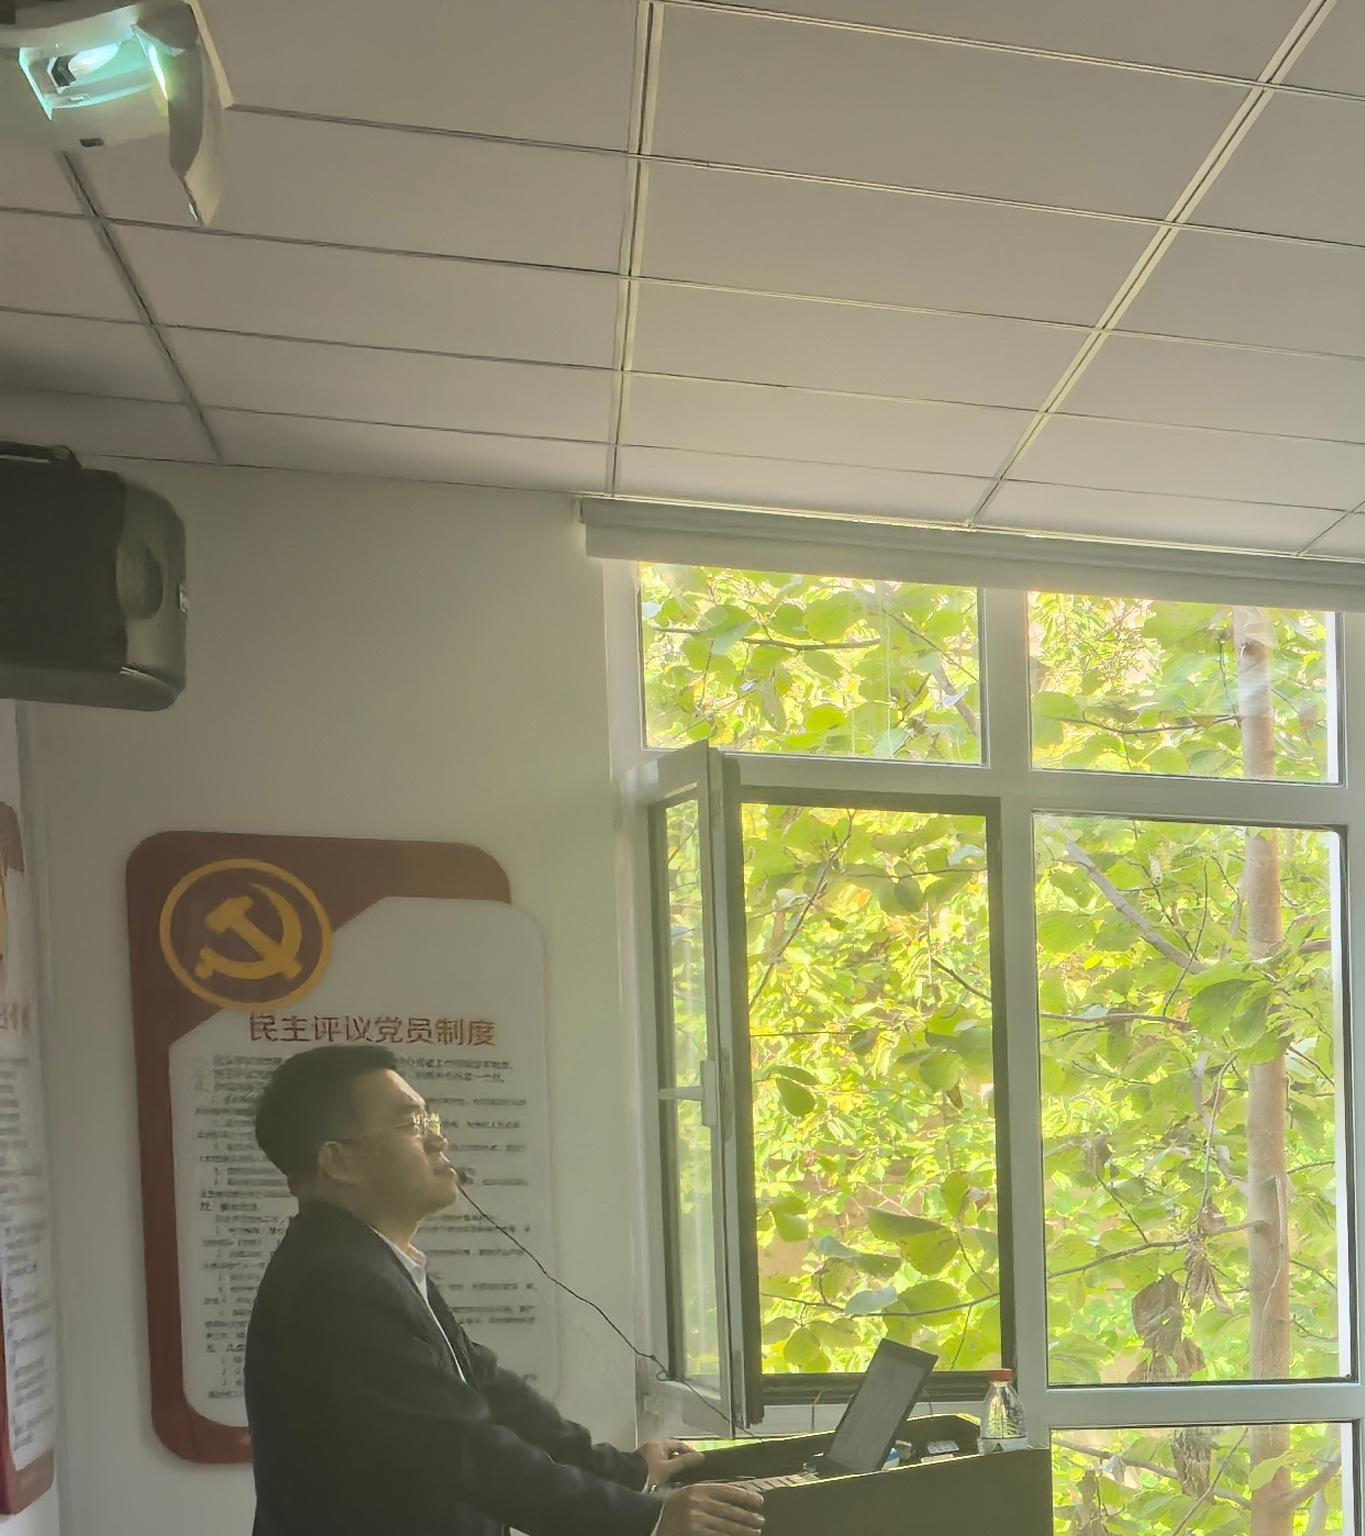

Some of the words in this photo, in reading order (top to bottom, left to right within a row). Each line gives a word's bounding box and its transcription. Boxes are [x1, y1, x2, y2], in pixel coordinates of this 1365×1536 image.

[249, 1013, 496, 1047] 民主评议党员制度
